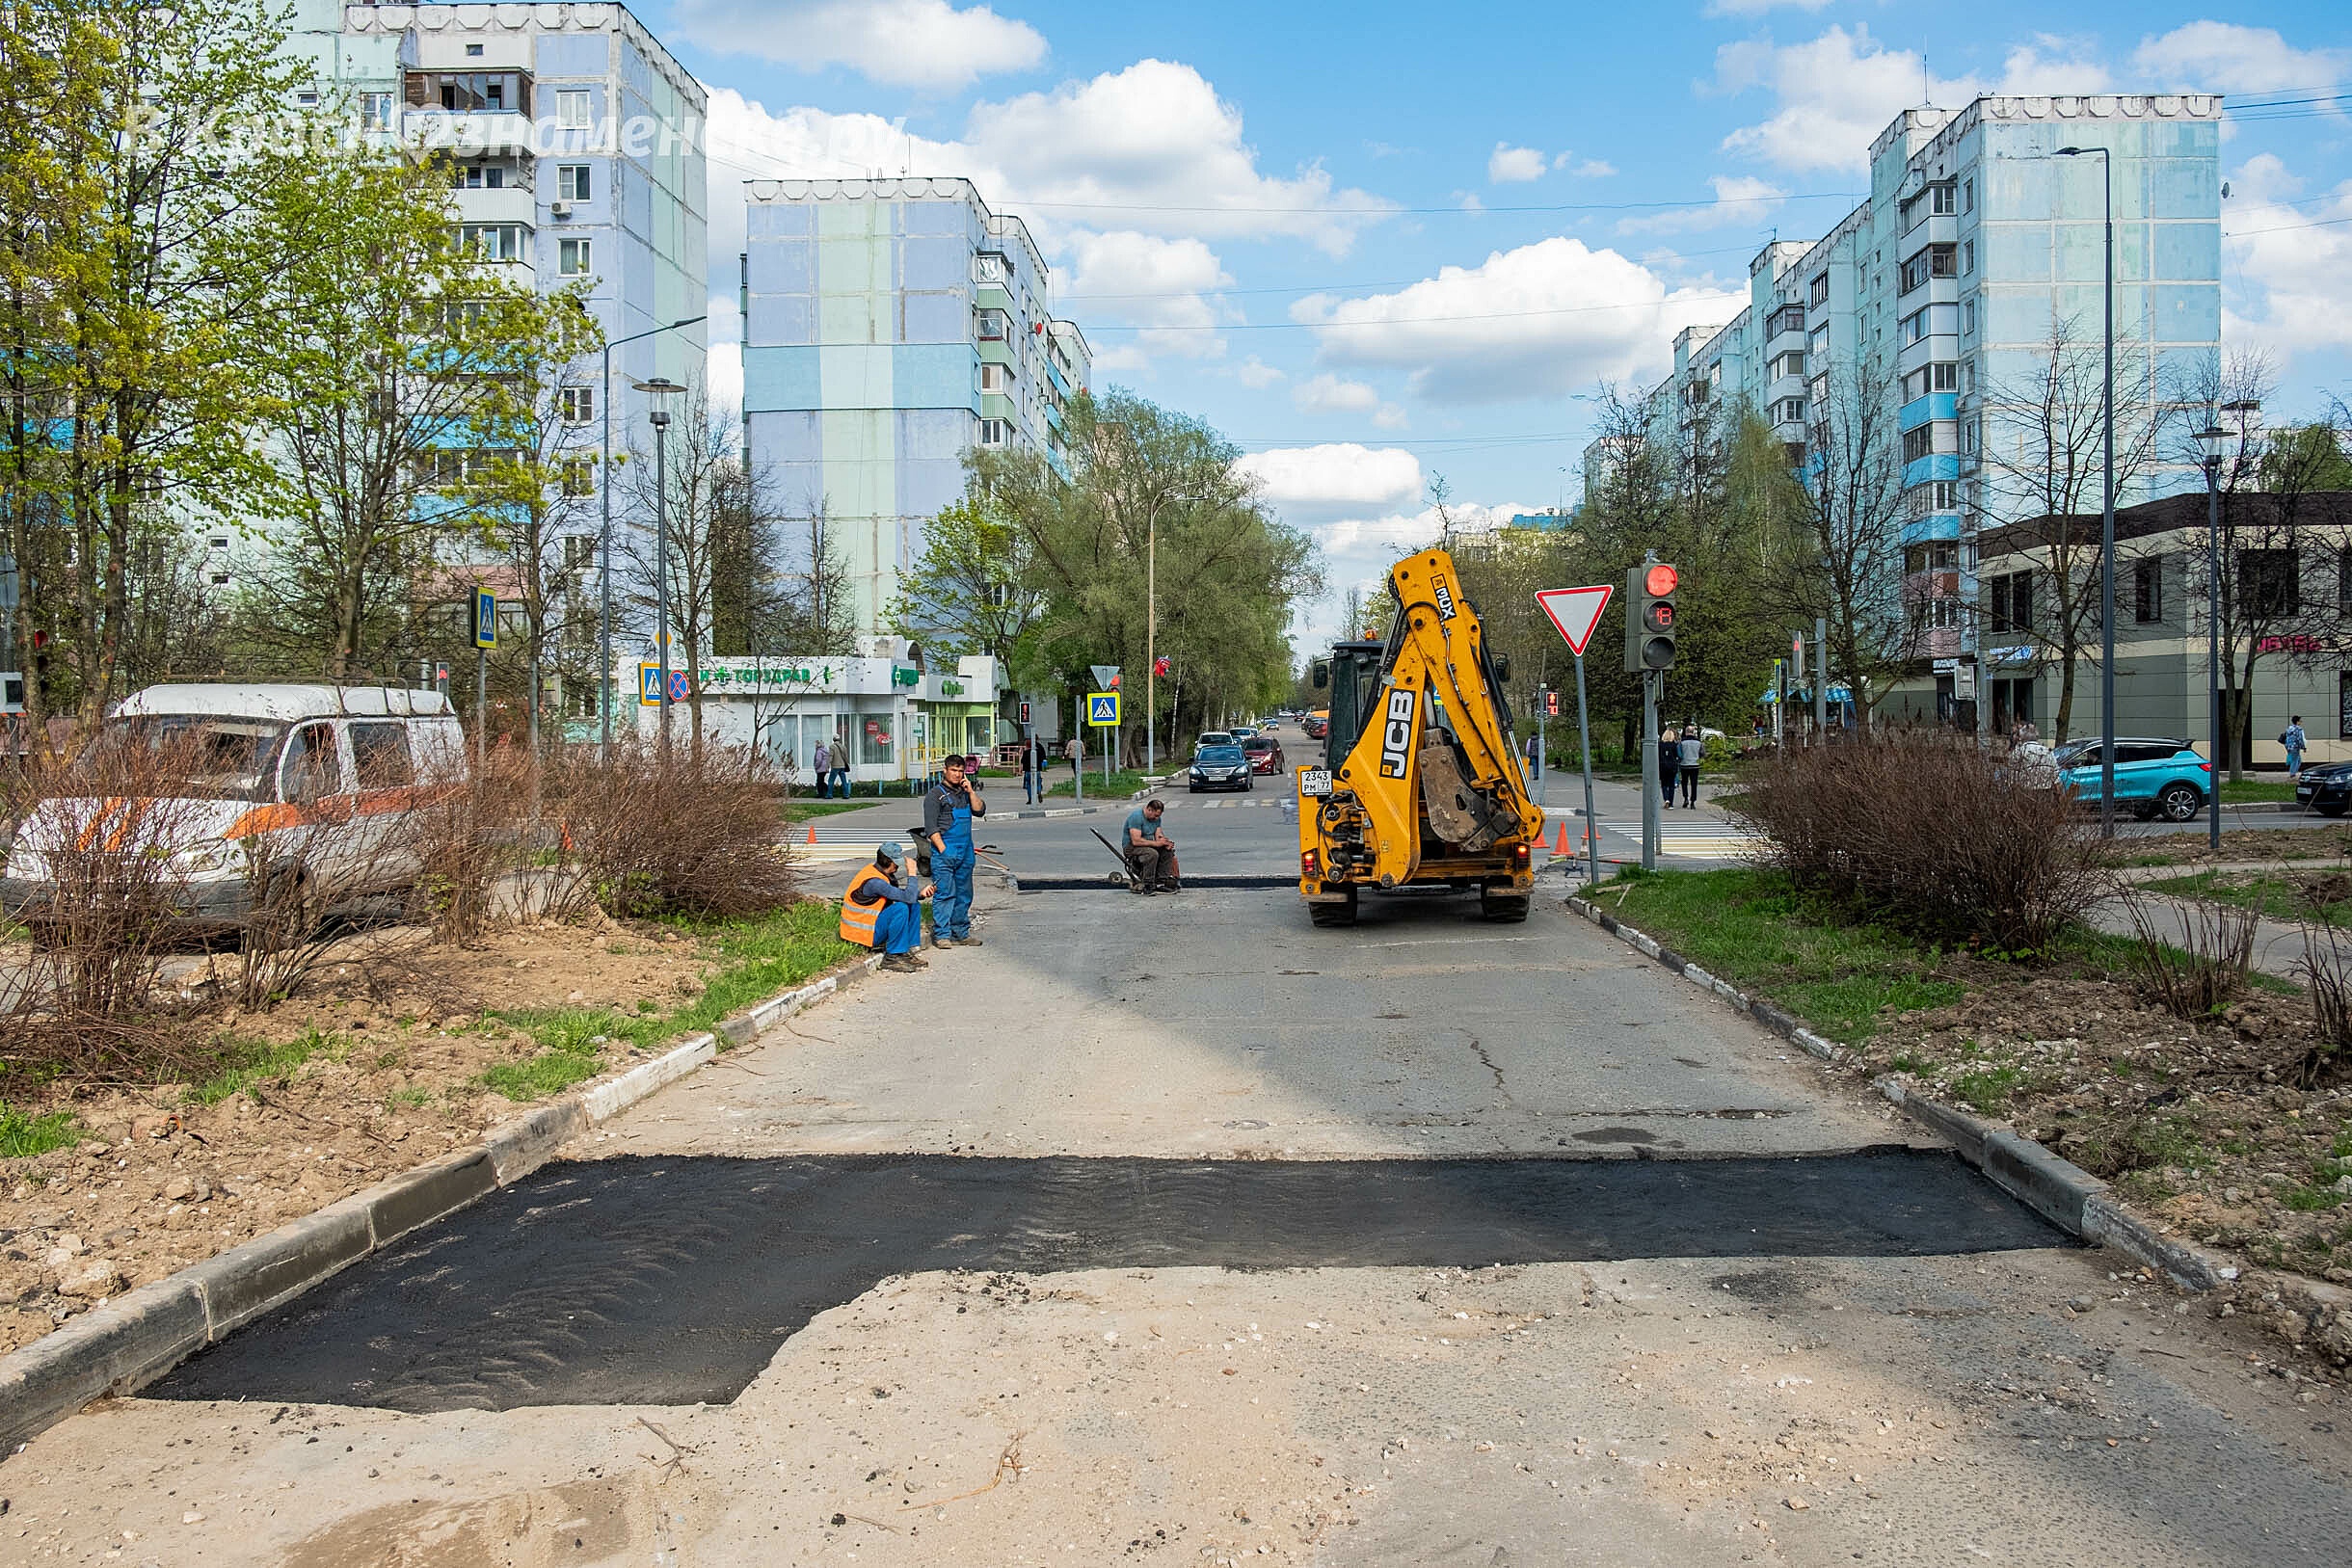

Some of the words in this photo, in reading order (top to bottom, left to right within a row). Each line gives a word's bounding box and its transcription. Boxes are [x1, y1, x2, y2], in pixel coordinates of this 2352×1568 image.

[1436, 587, 1457, 620] 3CX
[1383, 691, 1414, 778] JCB
[1305, 771, 1329, 782] 2343
